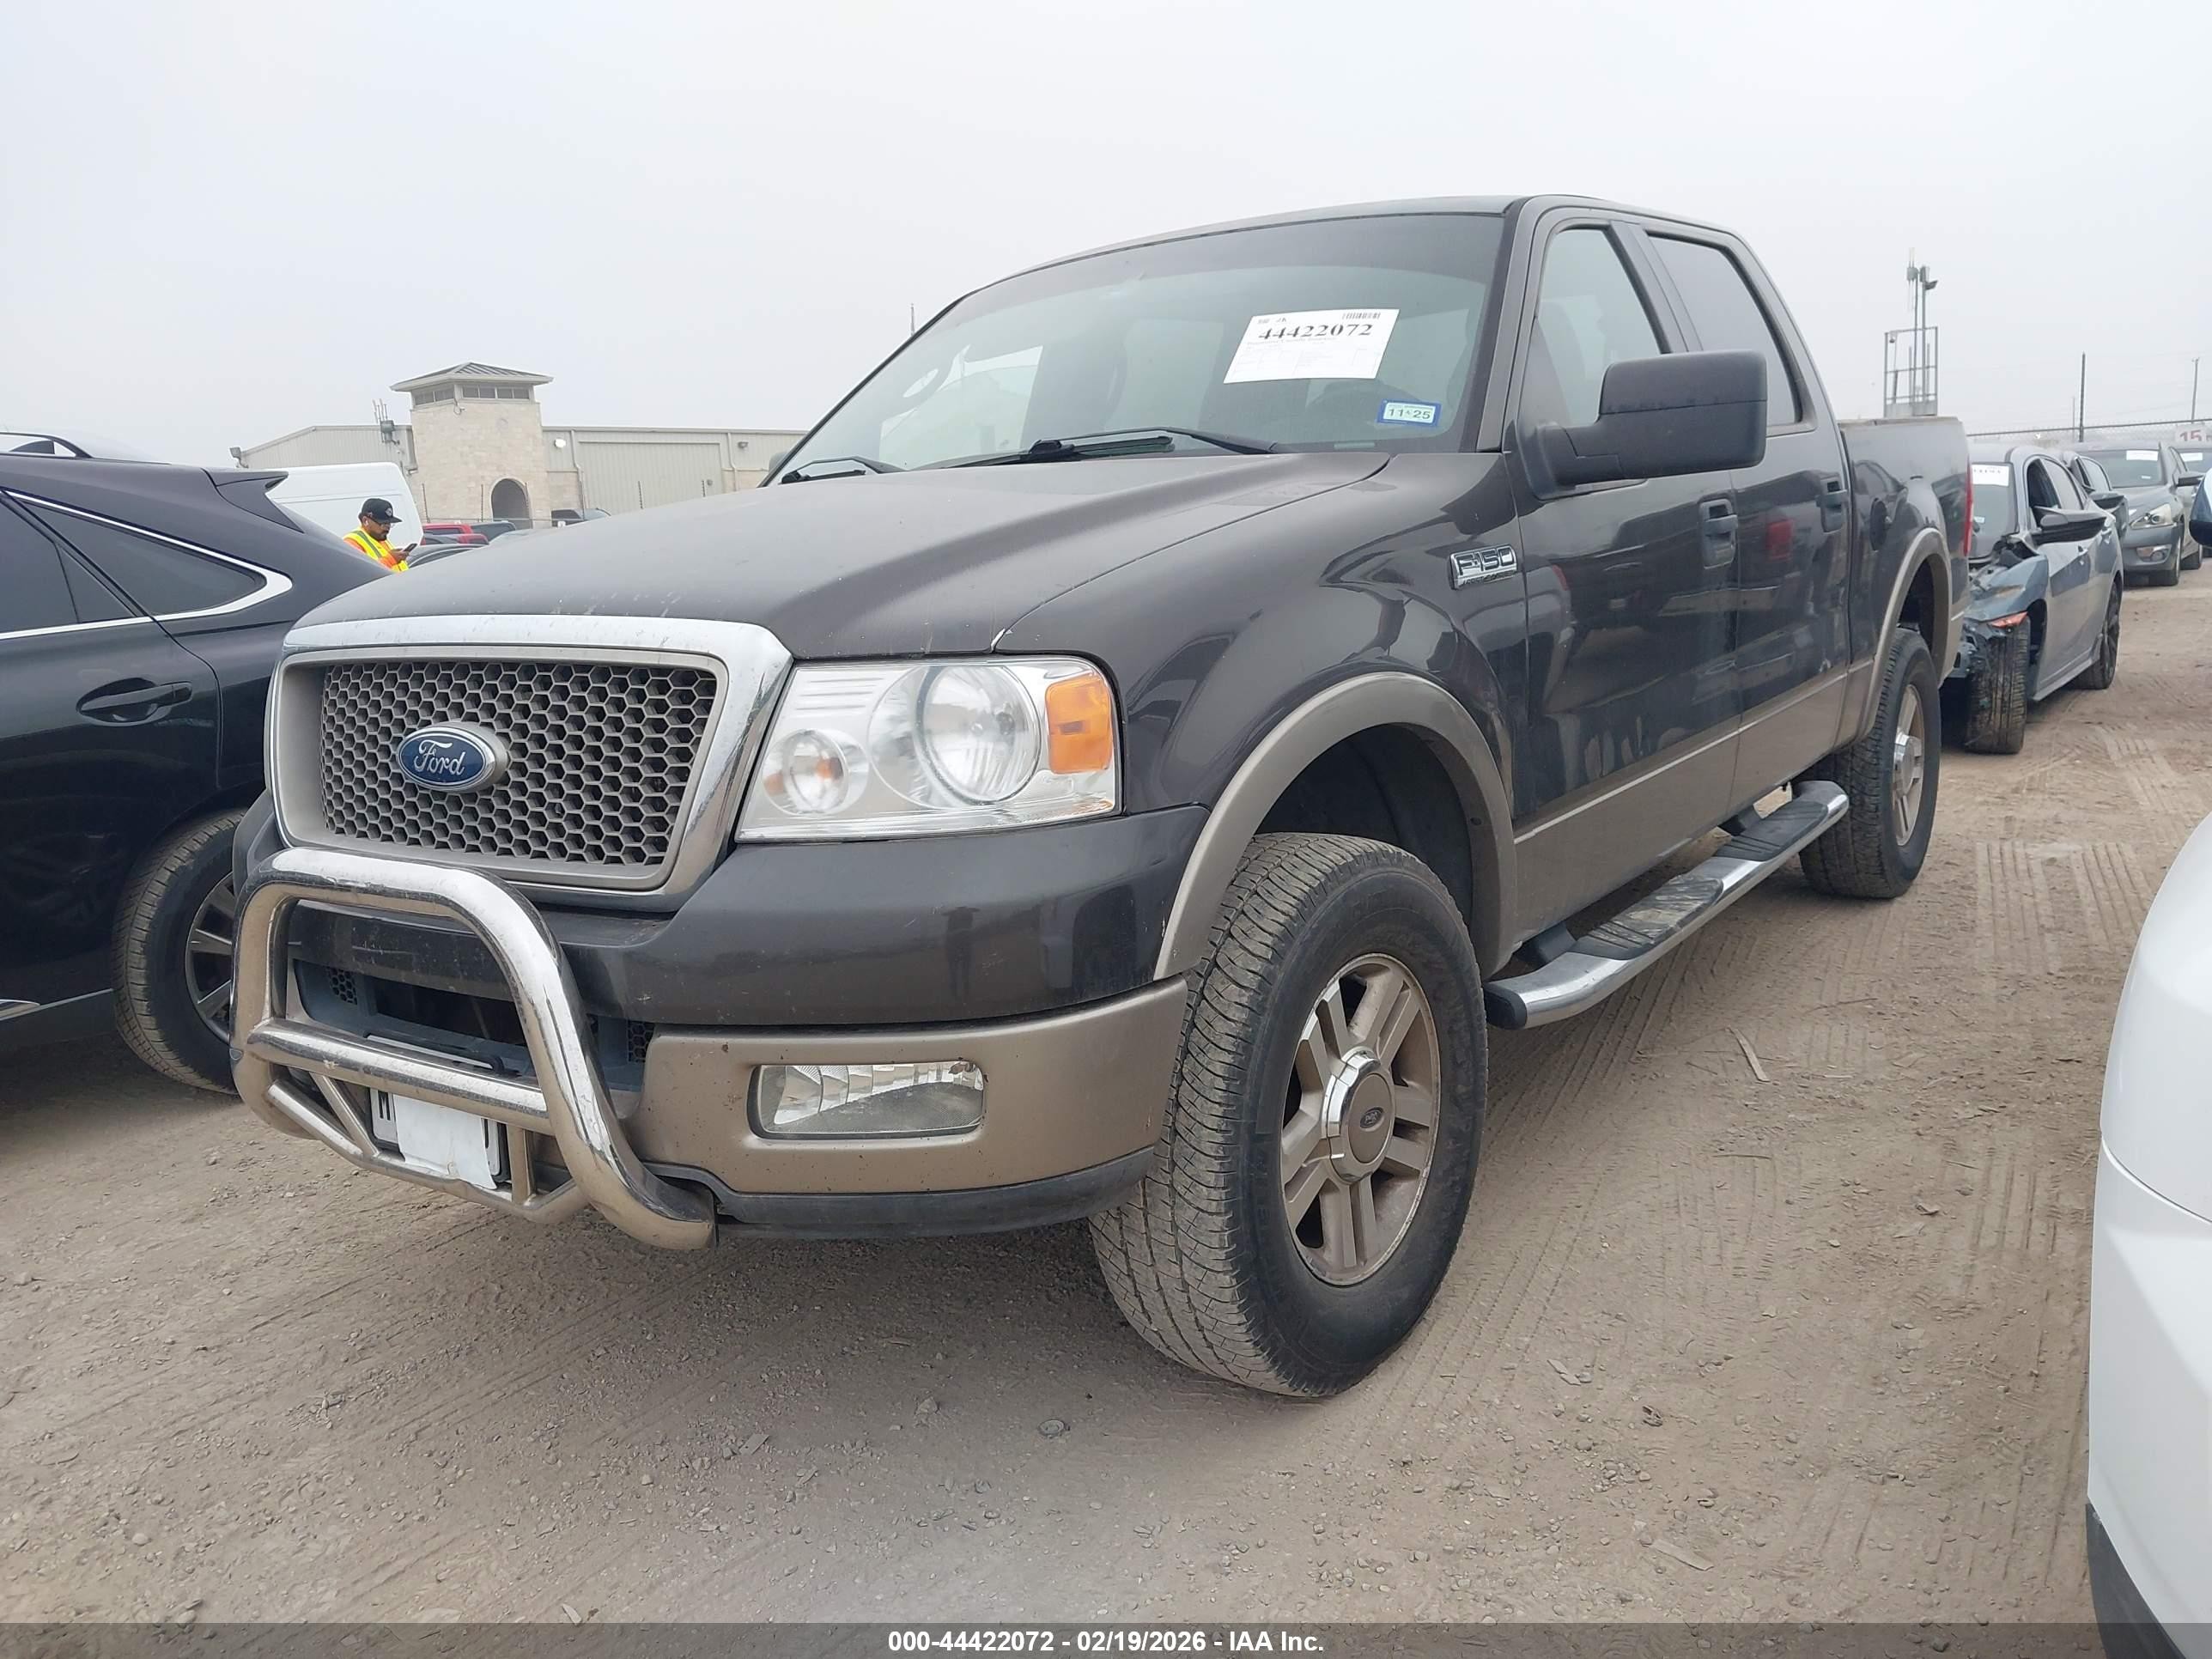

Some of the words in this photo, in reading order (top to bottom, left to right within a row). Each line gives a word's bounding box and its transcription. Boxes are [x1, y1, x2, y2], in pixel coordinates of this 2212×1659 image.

[1258, 324, 1374, 340] 44422072
[1413, 410, 1431, 420] 25
[414, 738, 466, 775] Ford
